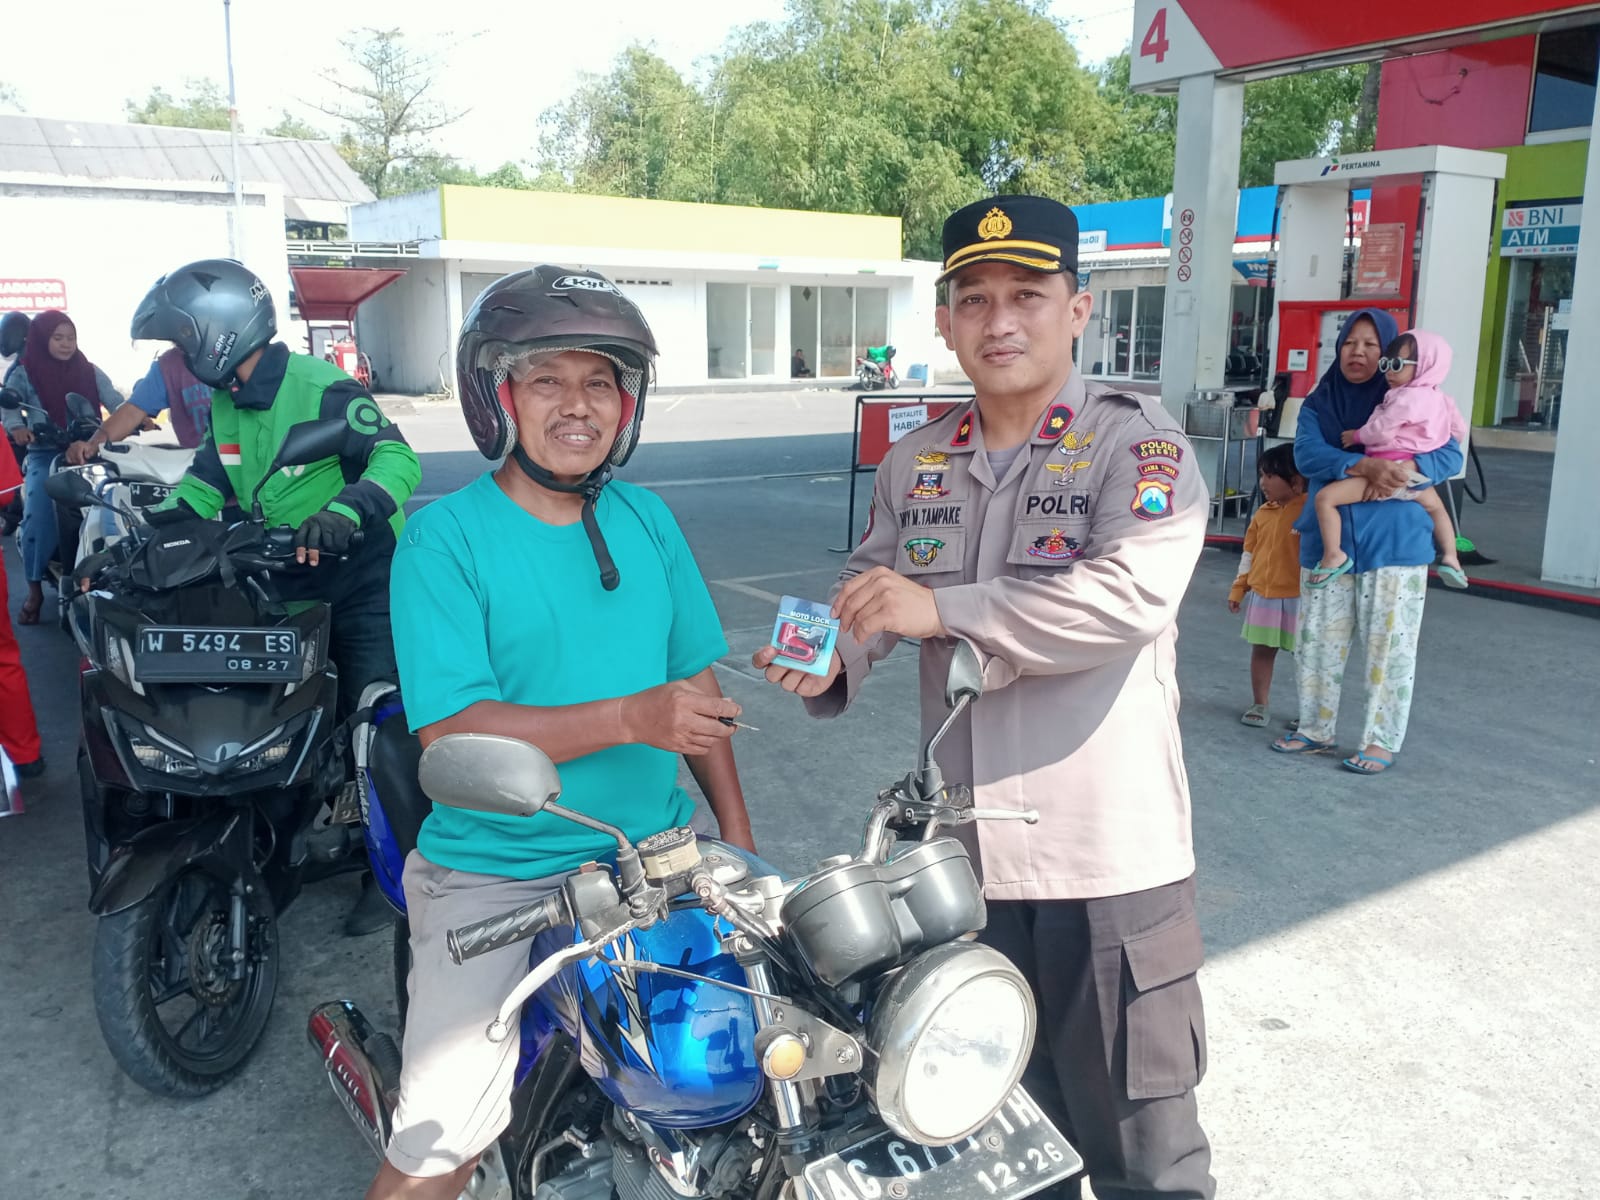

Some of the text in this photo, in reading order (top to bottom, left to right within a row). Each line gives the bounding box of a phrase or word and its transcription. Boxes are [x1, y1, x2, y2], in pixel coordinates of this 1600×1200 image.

[1140, 7, 1169, 63] 4
[1341, 160, 1380, 170] PERTAMINA
[1528, 207, 1564, 226] BNI
[1507, 228, 1550, 246] ATM
[891, 409, 923, 419] PERTALITE
[893, 420, 921, 432] HABIS
[131, 485, 140, 495] W
[1026, 494, 1090, 515] POLRI
[790, 610, 830, 625] MOTO LOCK
[148, 633, 291, 652] W 5494 ES
